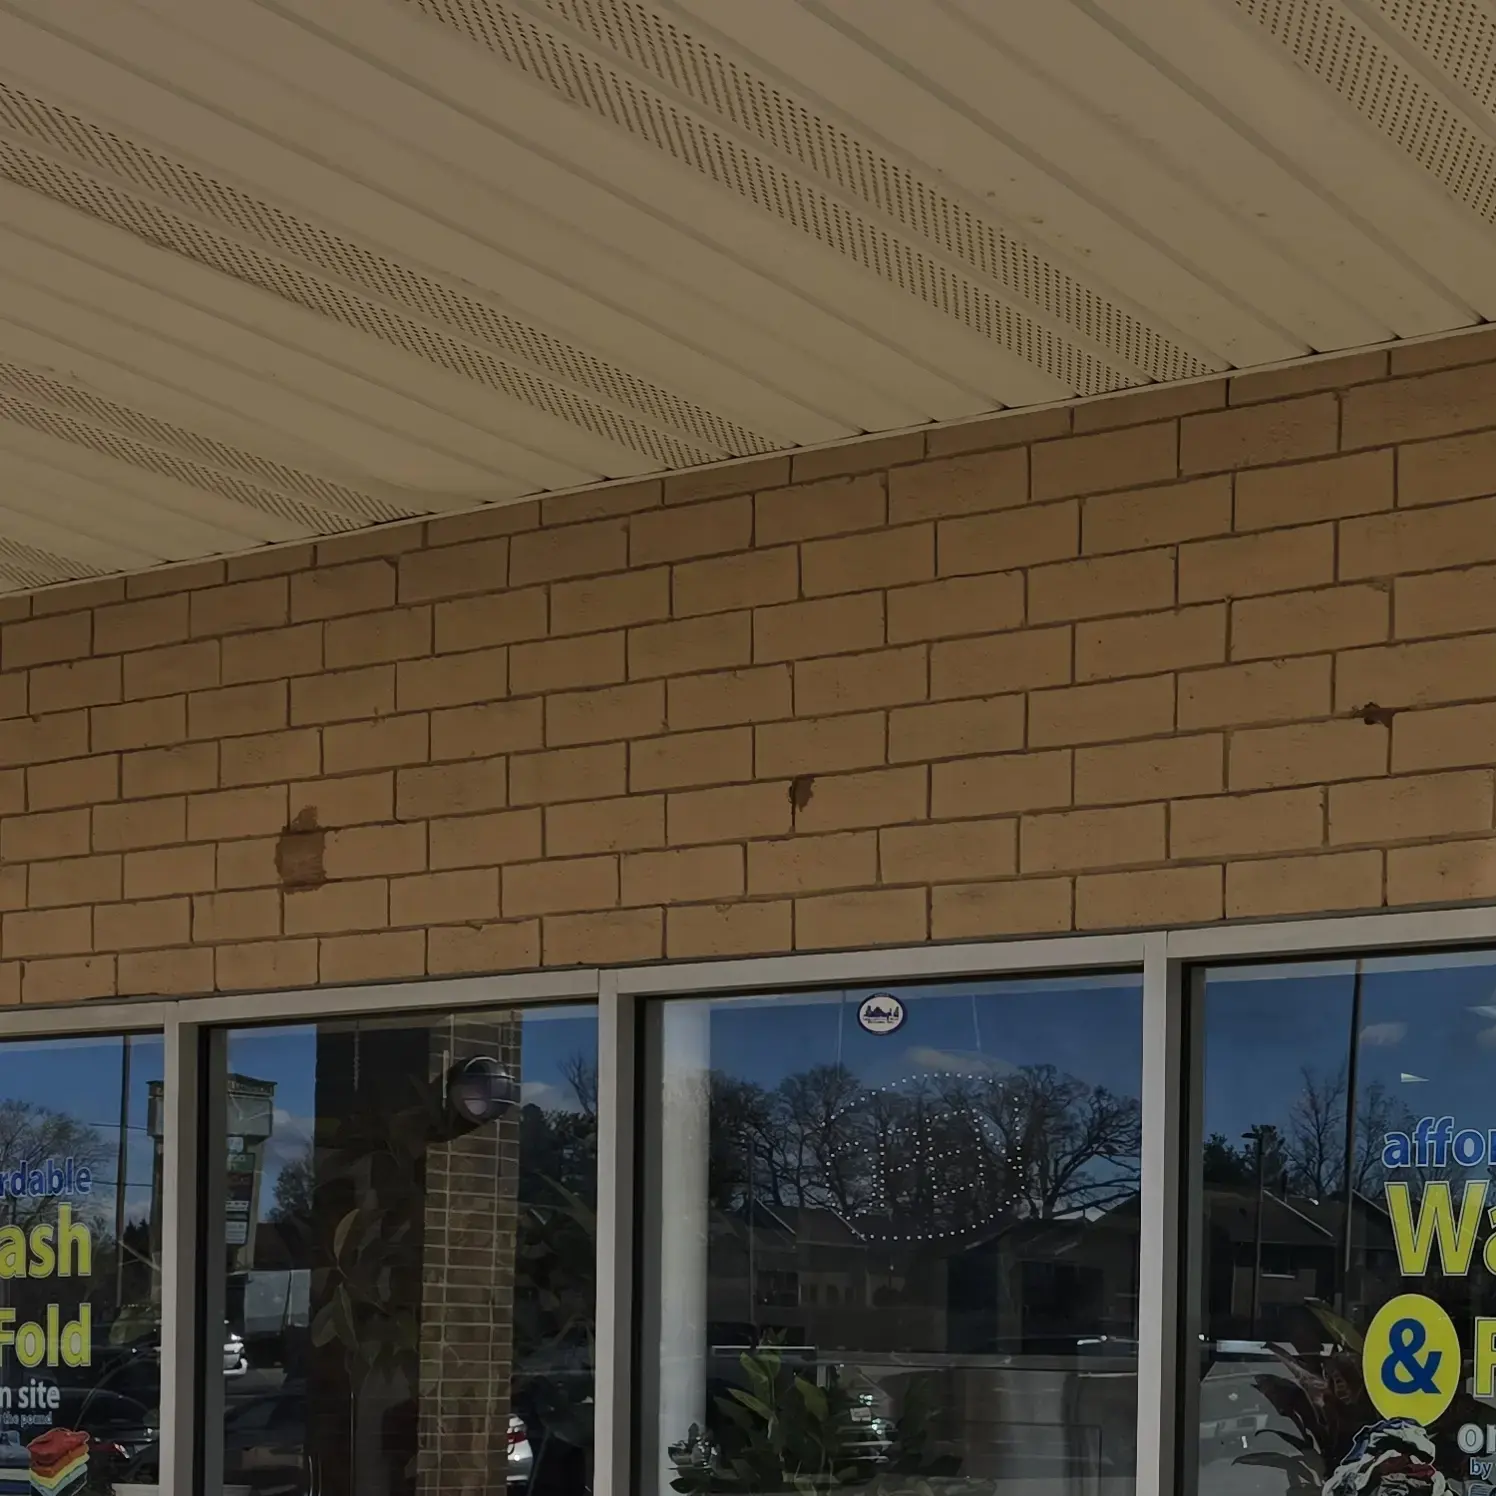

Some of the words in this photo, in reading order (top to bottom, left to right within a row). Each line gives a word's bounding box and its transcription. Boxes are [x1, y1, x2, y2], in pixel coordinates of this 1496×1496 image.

[0, 1302, 92, 1368] Fold
[1380, 1318, 1442, 1395] &
[18, 1378, 61, 1409] site
[1470, 1457, 1492, 1480] by
